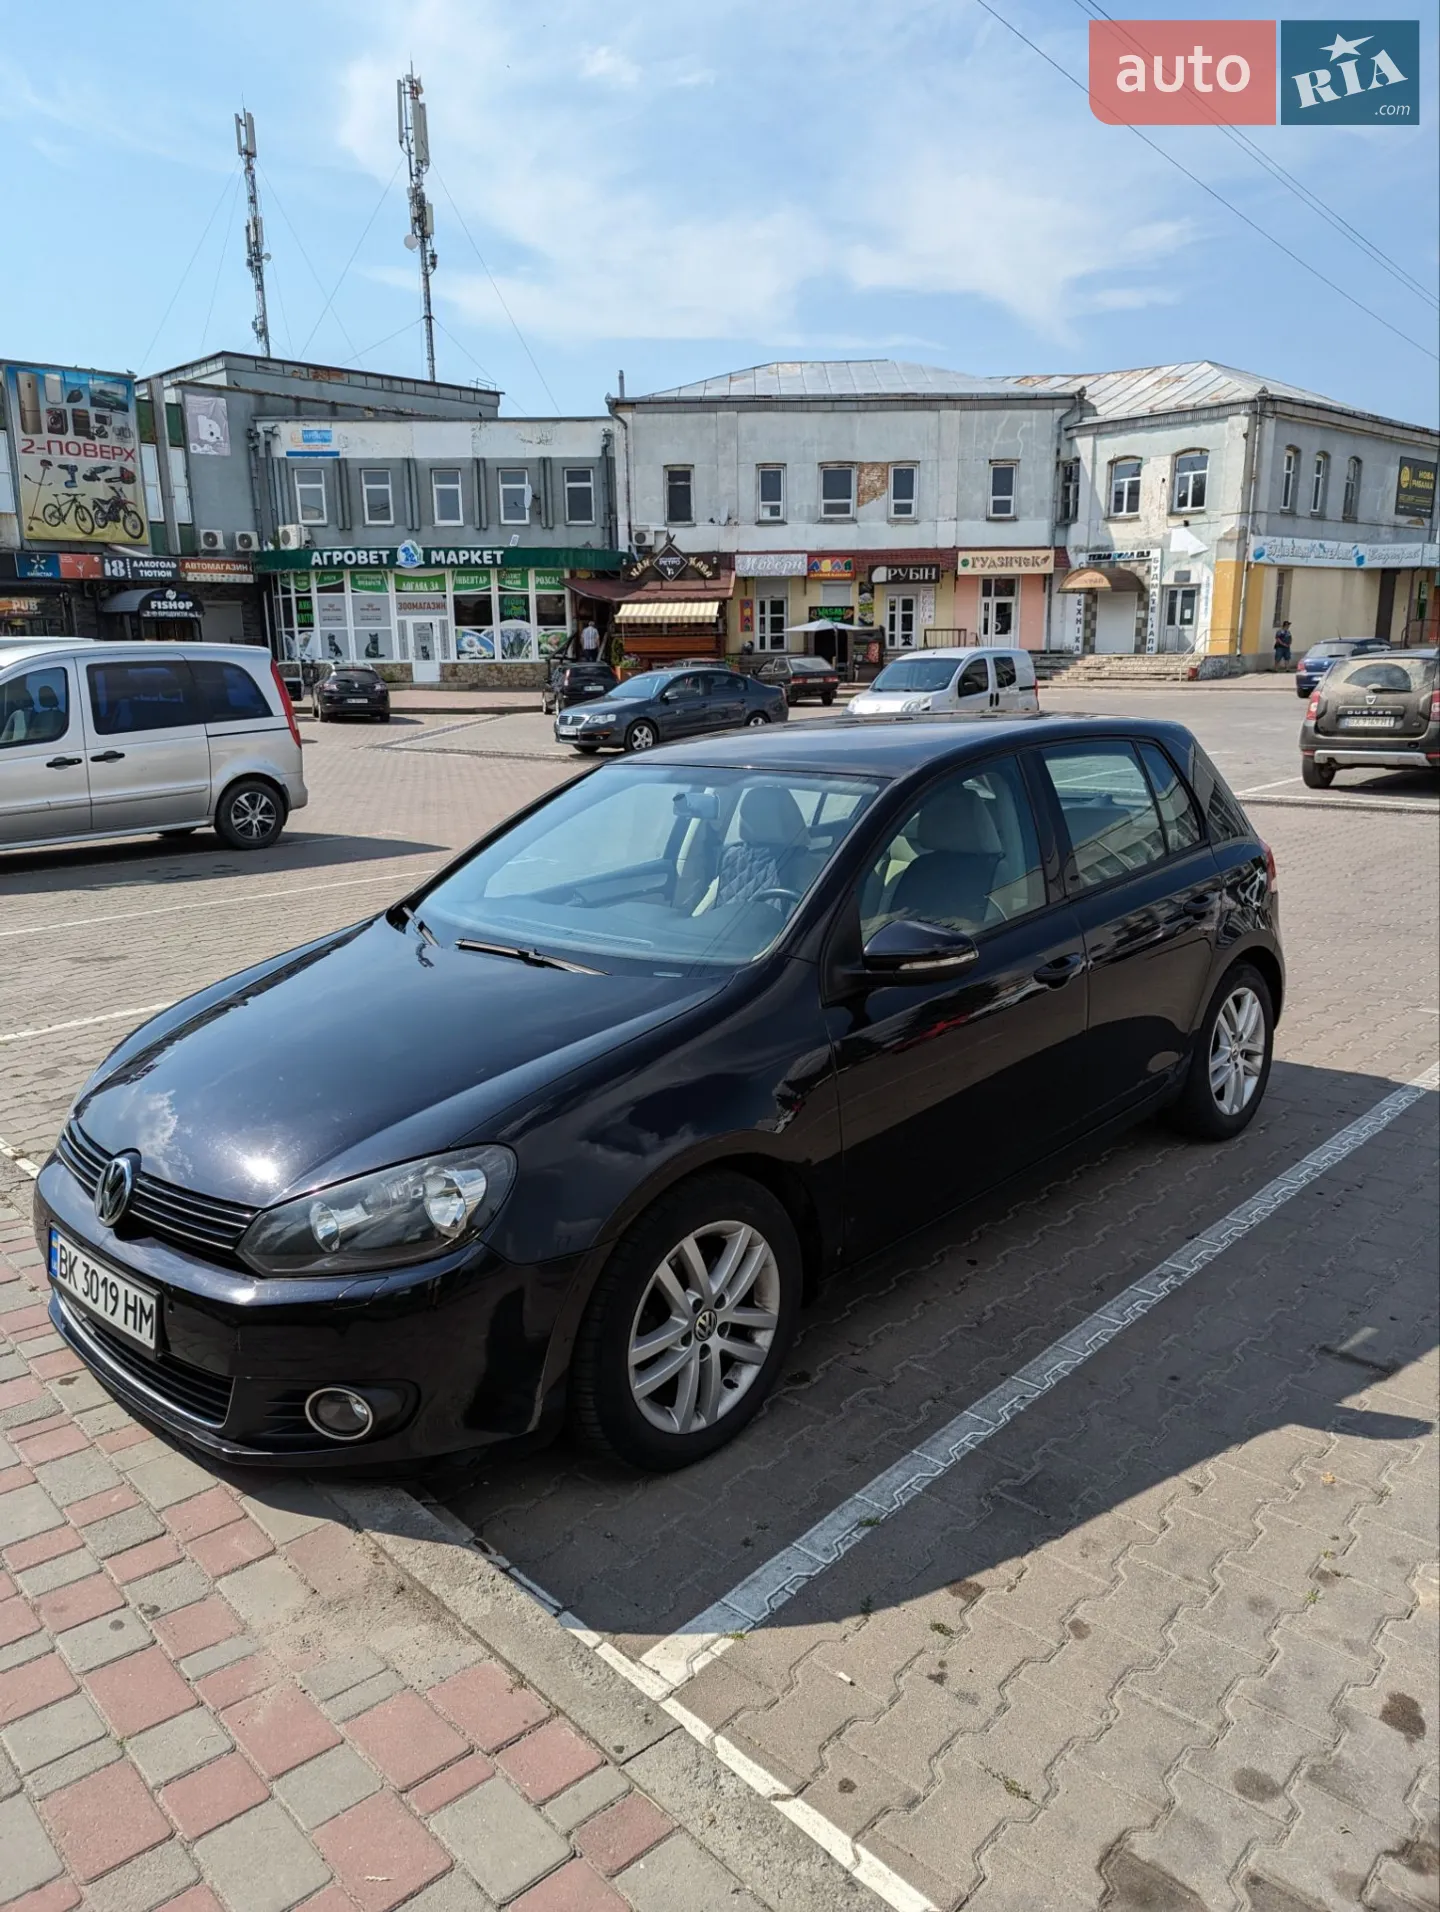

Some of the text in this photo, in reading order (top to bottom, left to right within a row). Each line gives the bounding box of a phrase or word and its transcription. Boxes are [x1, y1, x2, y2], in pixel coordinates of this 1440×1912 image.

[21, 438, 136, 463] 2-ПОВЕРХ
[311, 550, 504, 566] АГРОВЕТ МАРКЕТ
[132, 560, 177, 569] АЛКОГОЛЬ
[185, 561, 249, 571] АВТОМАГАЗИН
[139, 569, 172, 578] ТЮТЮН
[887, 567, 937, 581] РУБІН
[11, 599, 38, 611] PUB
[150, 600, 194, 611] FISHOP
[397, 602, 447, 611] ЗООМАГАЗИН
[59, 1244, 155, 1340] BK 3019 HM
